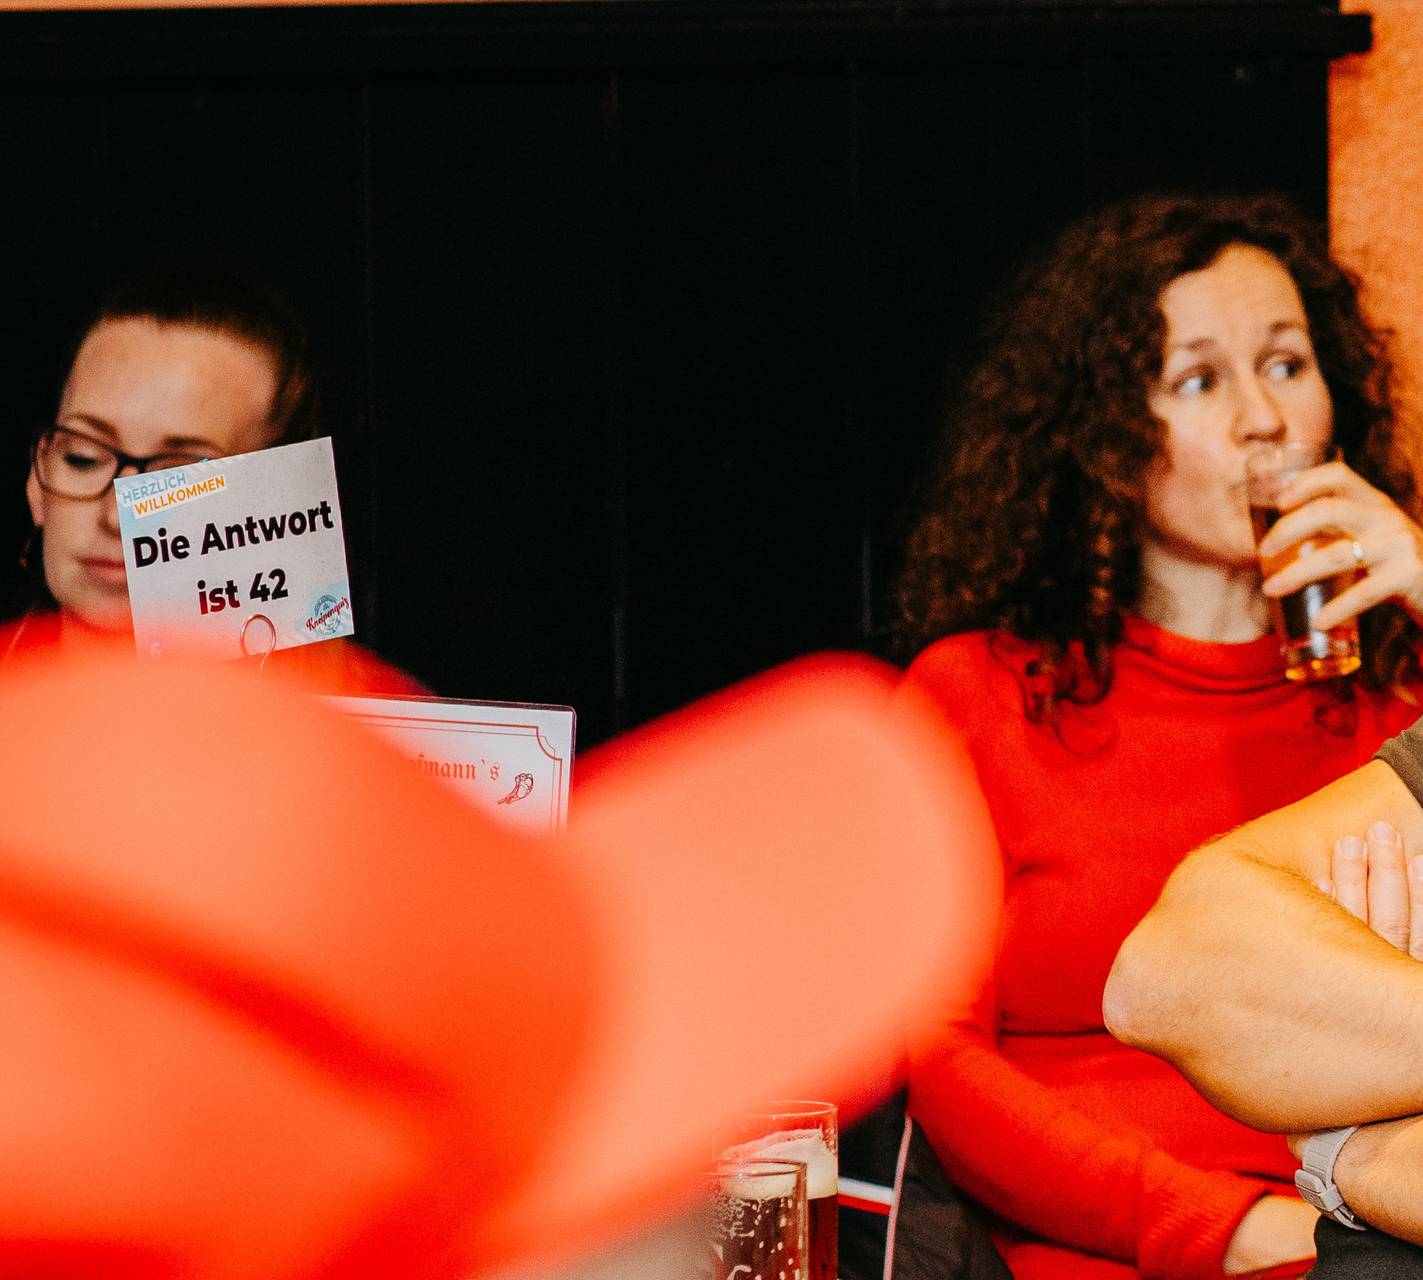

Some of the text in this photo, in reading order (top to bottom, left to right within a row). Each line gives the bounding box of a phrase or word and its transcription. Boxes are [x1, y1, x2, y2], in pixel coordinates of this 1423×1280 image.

[123, 473, 186, 503] HERZLICH
[135, 476, 225, 515] WILLKOMMEN
[132, 501, 334, 568] Die Antwort
[197, 568, 289, 615] ist 42
